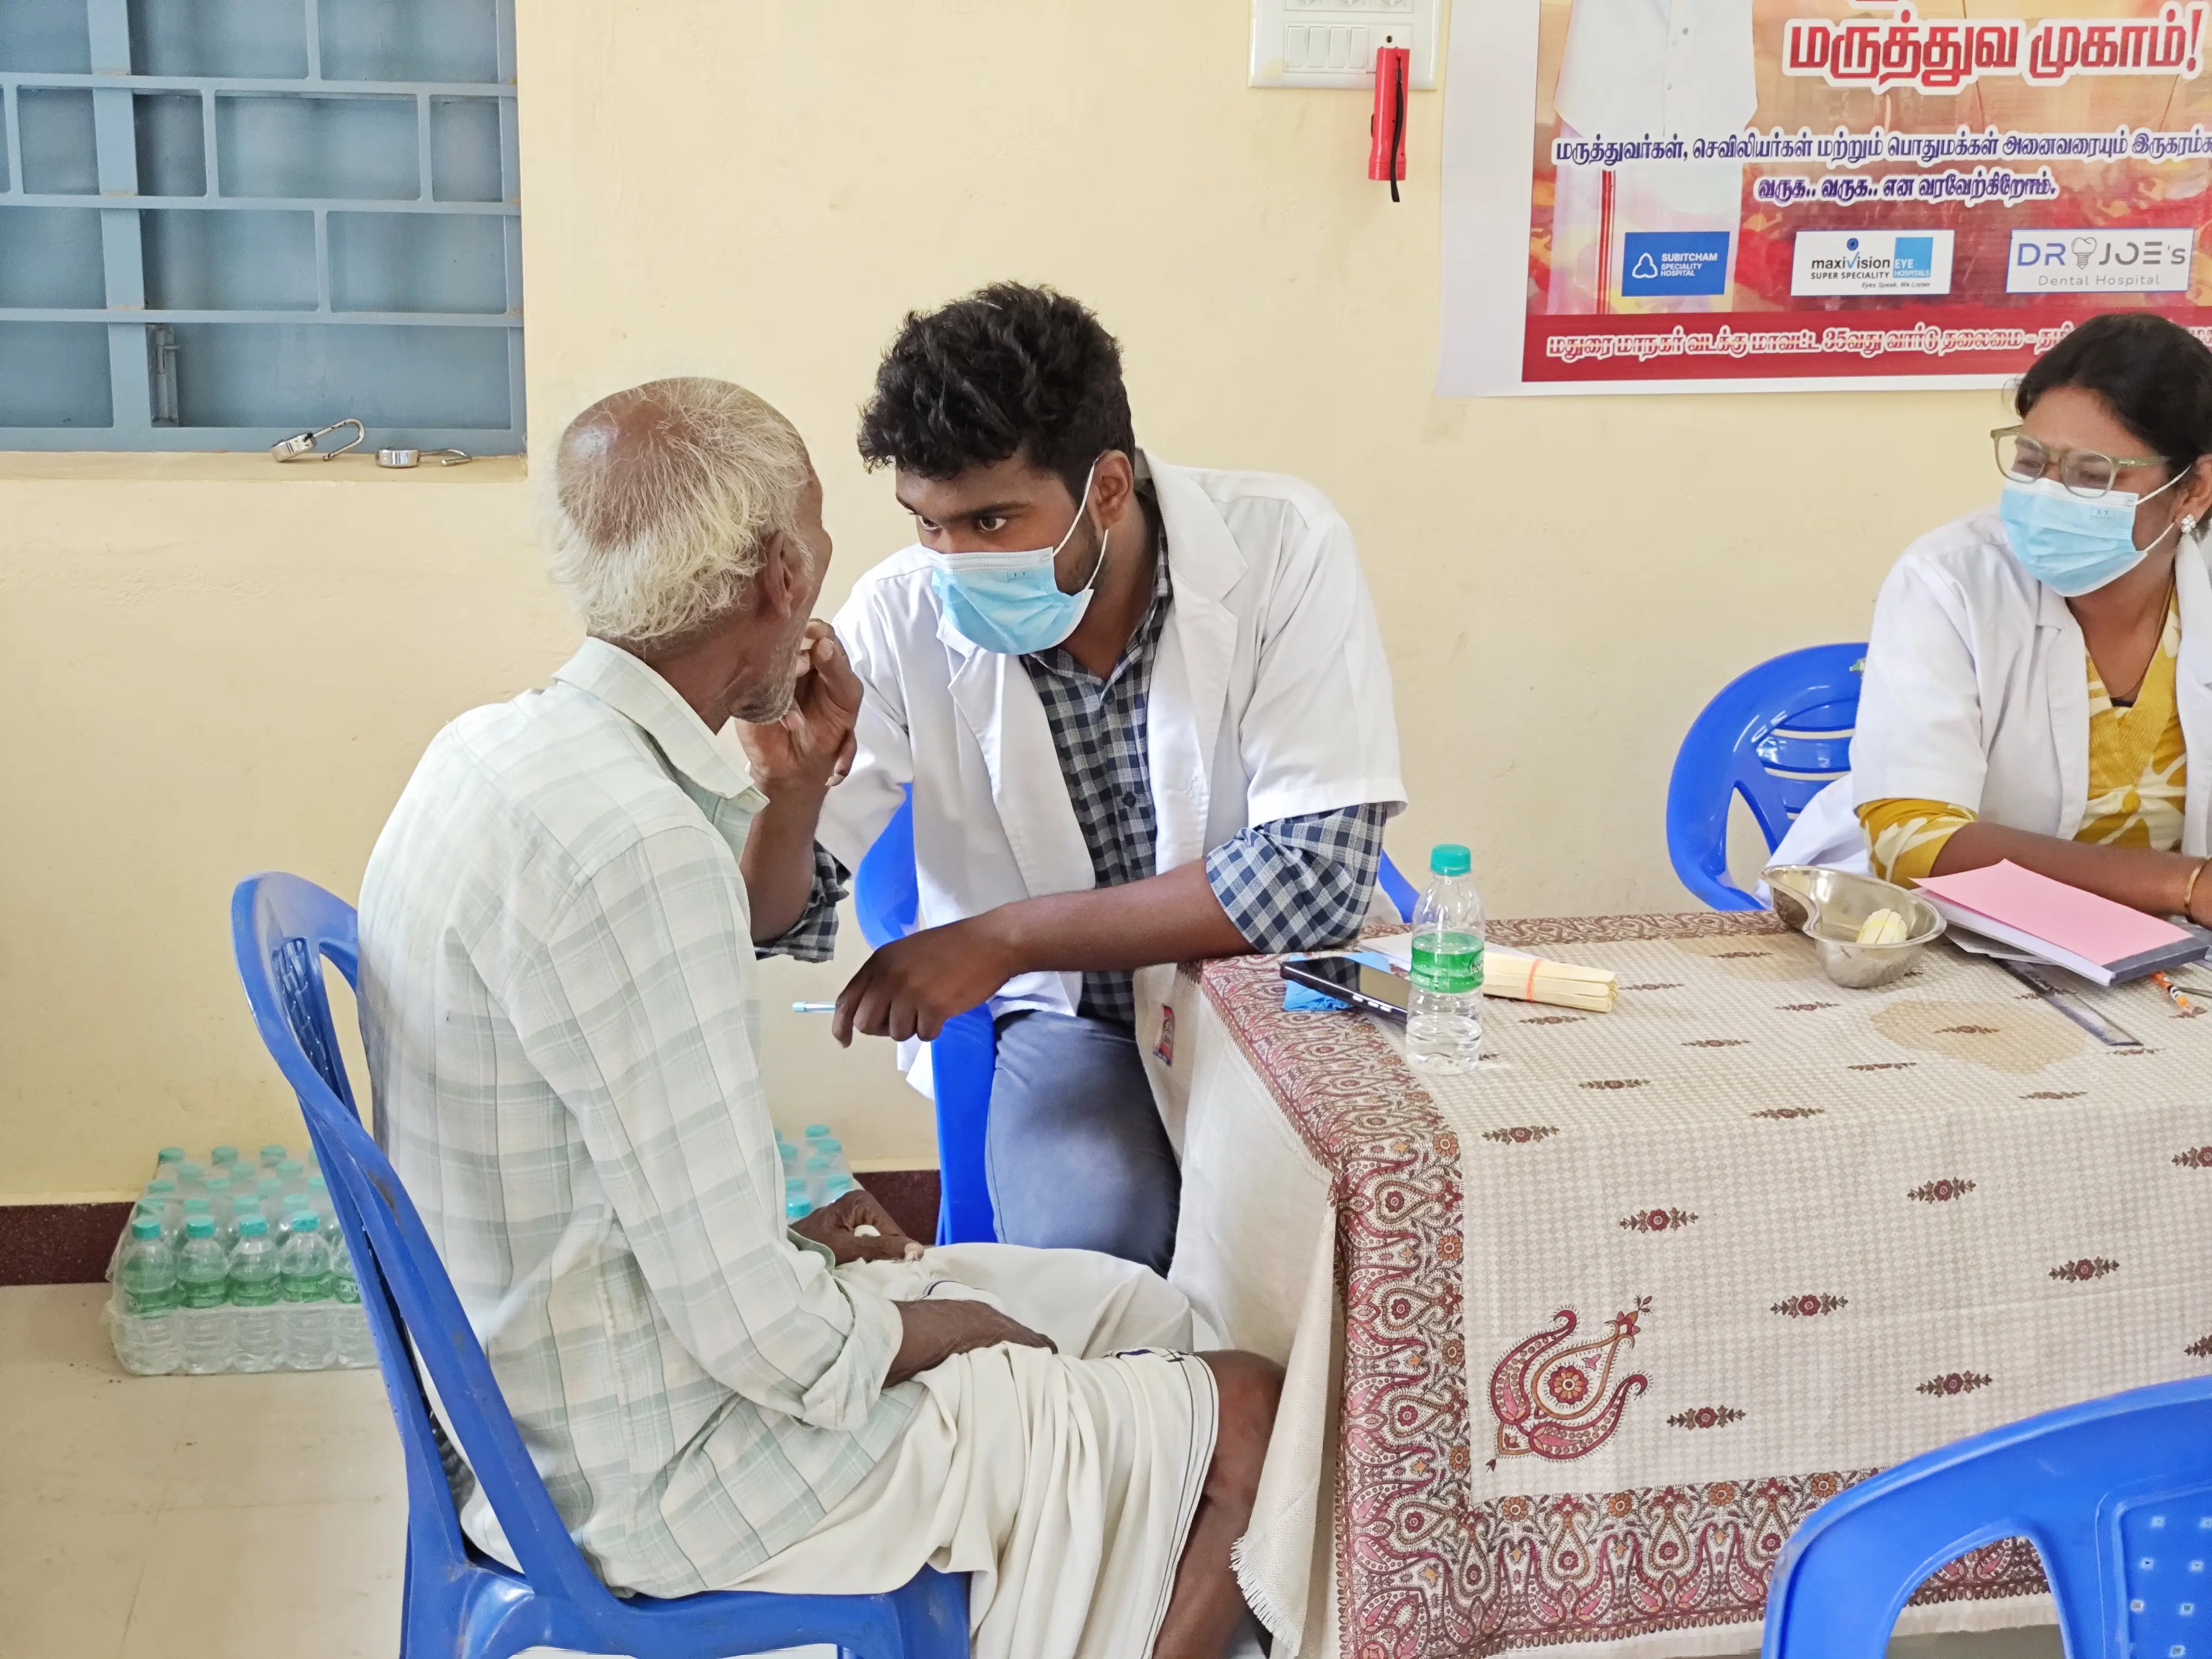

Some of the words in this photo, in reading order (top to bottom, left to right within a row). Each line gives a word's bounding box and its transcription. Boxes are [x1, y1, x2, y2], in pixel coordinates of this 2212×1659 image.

[1789, 9, 2018, 87] மருத்துவ
[2029, 8, 2202, 78] முகாம்!
[1557, 133, 1688, 166] மருத்துவர்கள்,
[1693, 132, 1813, 158] செவிலியர்கள்
[1817, 131, 1882, 163] மற்றும்
[1888, 130, 1999, 162] பொதுமக்கள்
[2002, 129, 2128, 158] அனைவரையும்
[1883, 178, 1914, 196] என
[1918, 170, 2056, 201] வரவேற்கிறோம்.
[1661, 253, 1718, 262] SUBITCHAM
[1895, 259, 1914, 269] EYE
[2017, 243, 2066, 266] DR
[2039, 275, 2089, 286] Dental
[2095, 275, 2160, 287] Hospital
[1548, 337, 1613, 361] மதுரை
[1615, 326, 1684, 359] மாநகர்
[1687, 326, 1747, 356] வடக்கு
